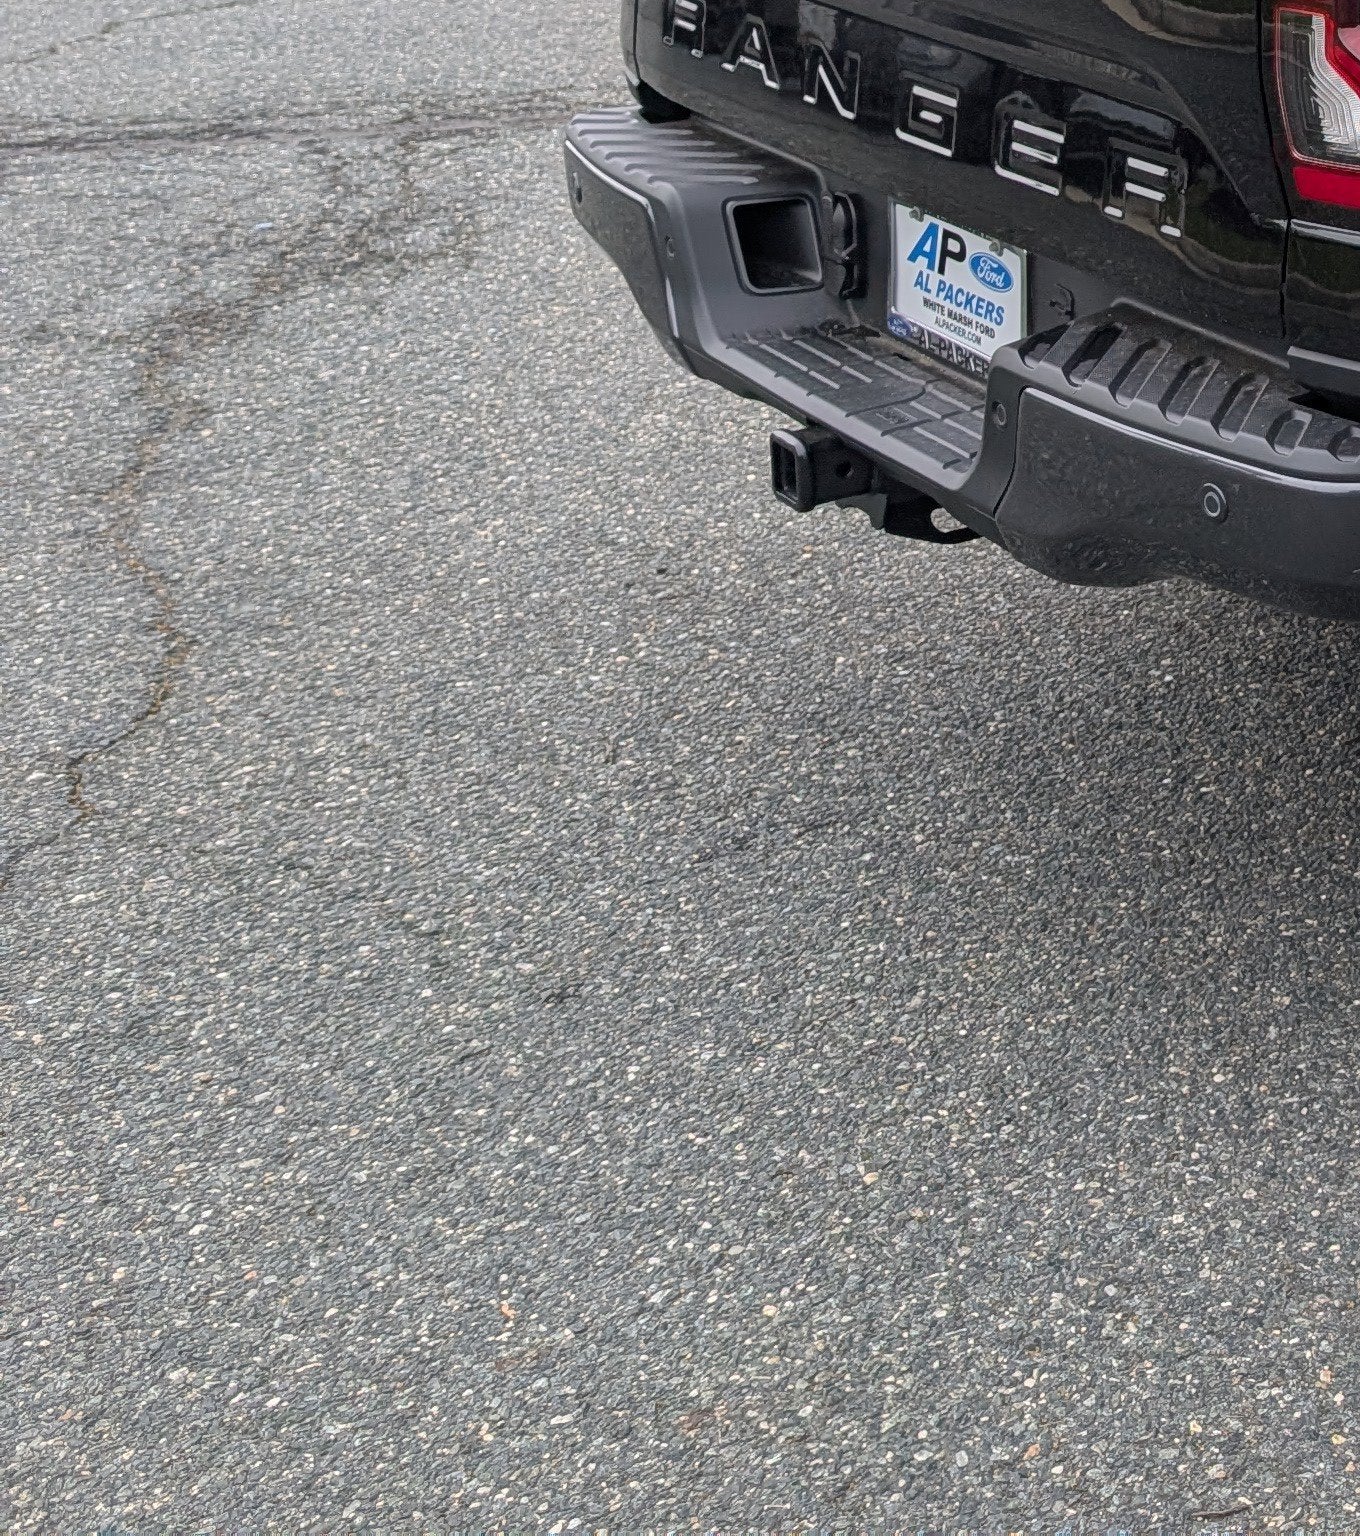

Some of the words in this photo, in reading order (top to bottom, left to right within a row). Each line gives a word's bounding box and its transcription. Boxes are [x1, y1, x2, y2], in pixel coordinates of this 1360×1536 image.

[906, 221, 967, 276] AP
[976, 255, 1006, 287] Ford
[913, 270, 932, 295] AL
[935, 278, 1005, 327] PACKERS
[922, 295, 946, 317] WHITE
[947, 307, 974, 330] MARSH
[975, 320, 996, 340] FORD
